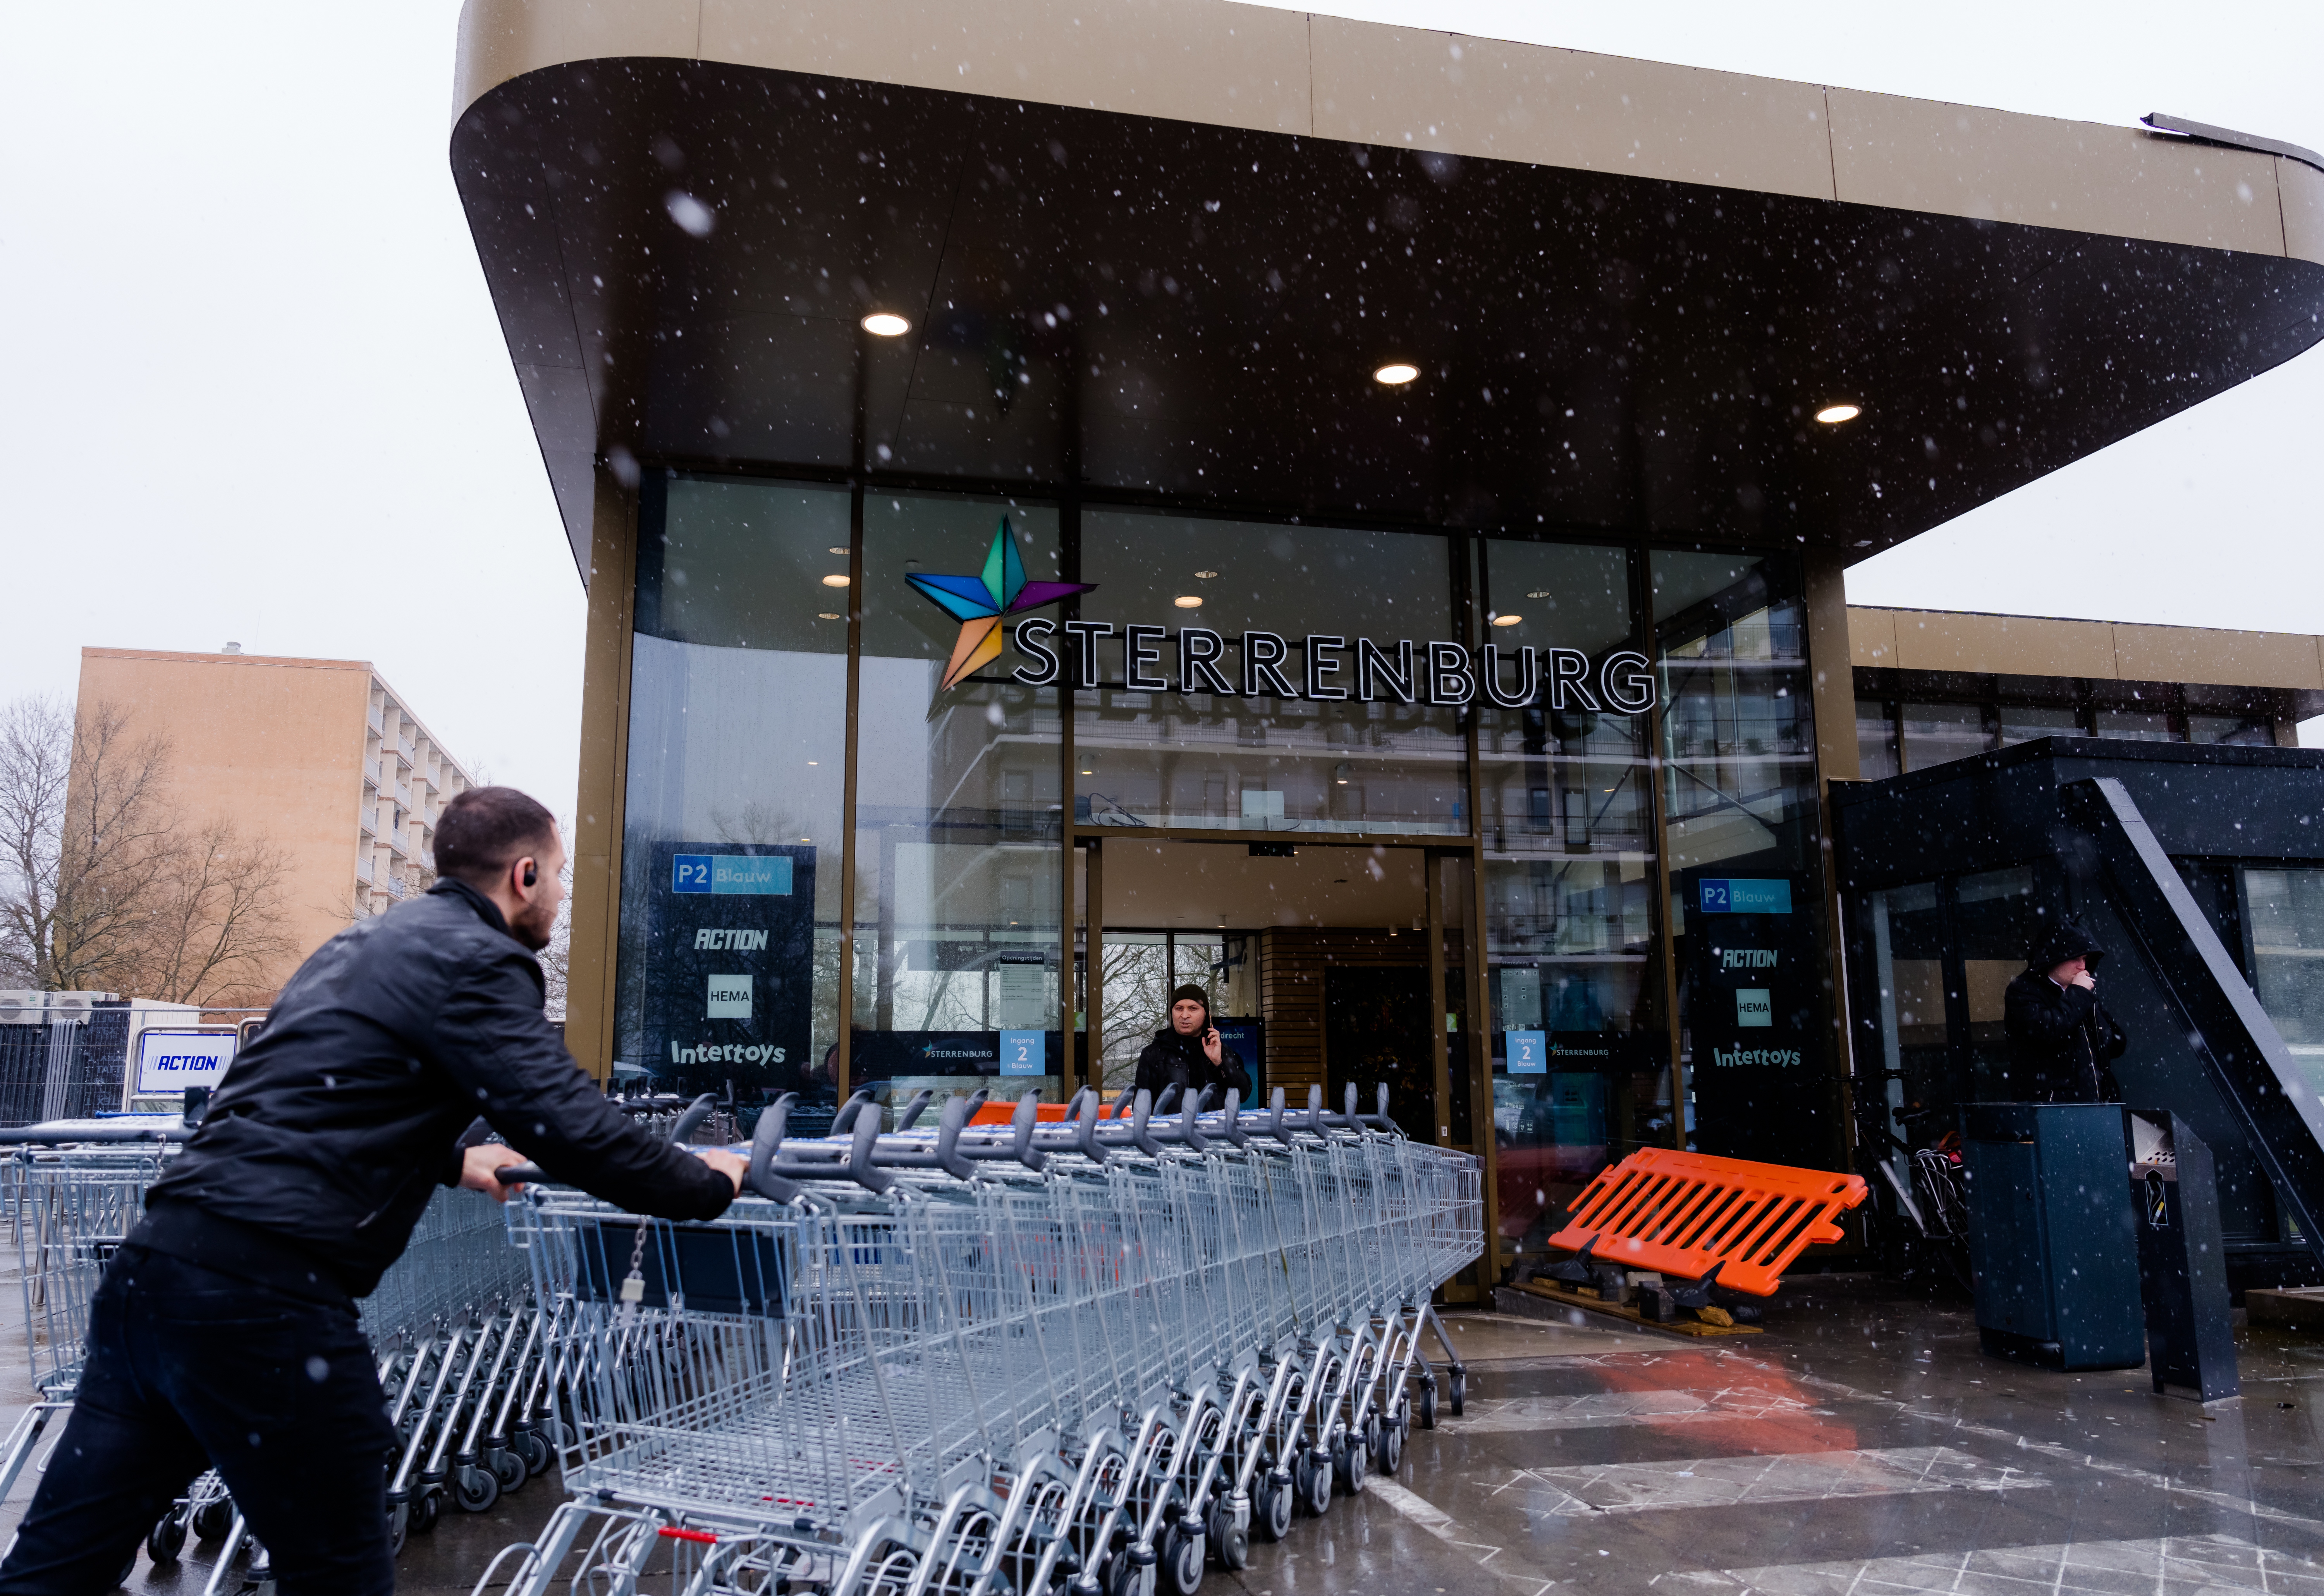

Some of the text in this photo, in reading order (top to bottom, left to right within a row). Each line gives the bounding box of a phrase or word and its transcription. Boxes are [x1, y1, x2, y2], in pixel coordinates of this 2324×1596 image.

[1012, 617, 1655, 714] STERRENBURG
[679, 863, 771, 883] P2 Blauw
[1705, 888, 1775, 904] P2 Blauw
[694, 929, 768, 950] ACTION
[1723, 949, 1777, 967] ACTION
[711, 991, 749, 1001] HEMA
[1740, 1003, 1769, 1012] HEMA
[671, 1040, 786, 1066] Intertoys
[1018, 1047, 1027, 1061] 2
[1522, 1046, 1531, 1059] 2
[1714, 1047, 1800, 1068] Intertoys
[158, 1056, 218, 1070] ACTION
